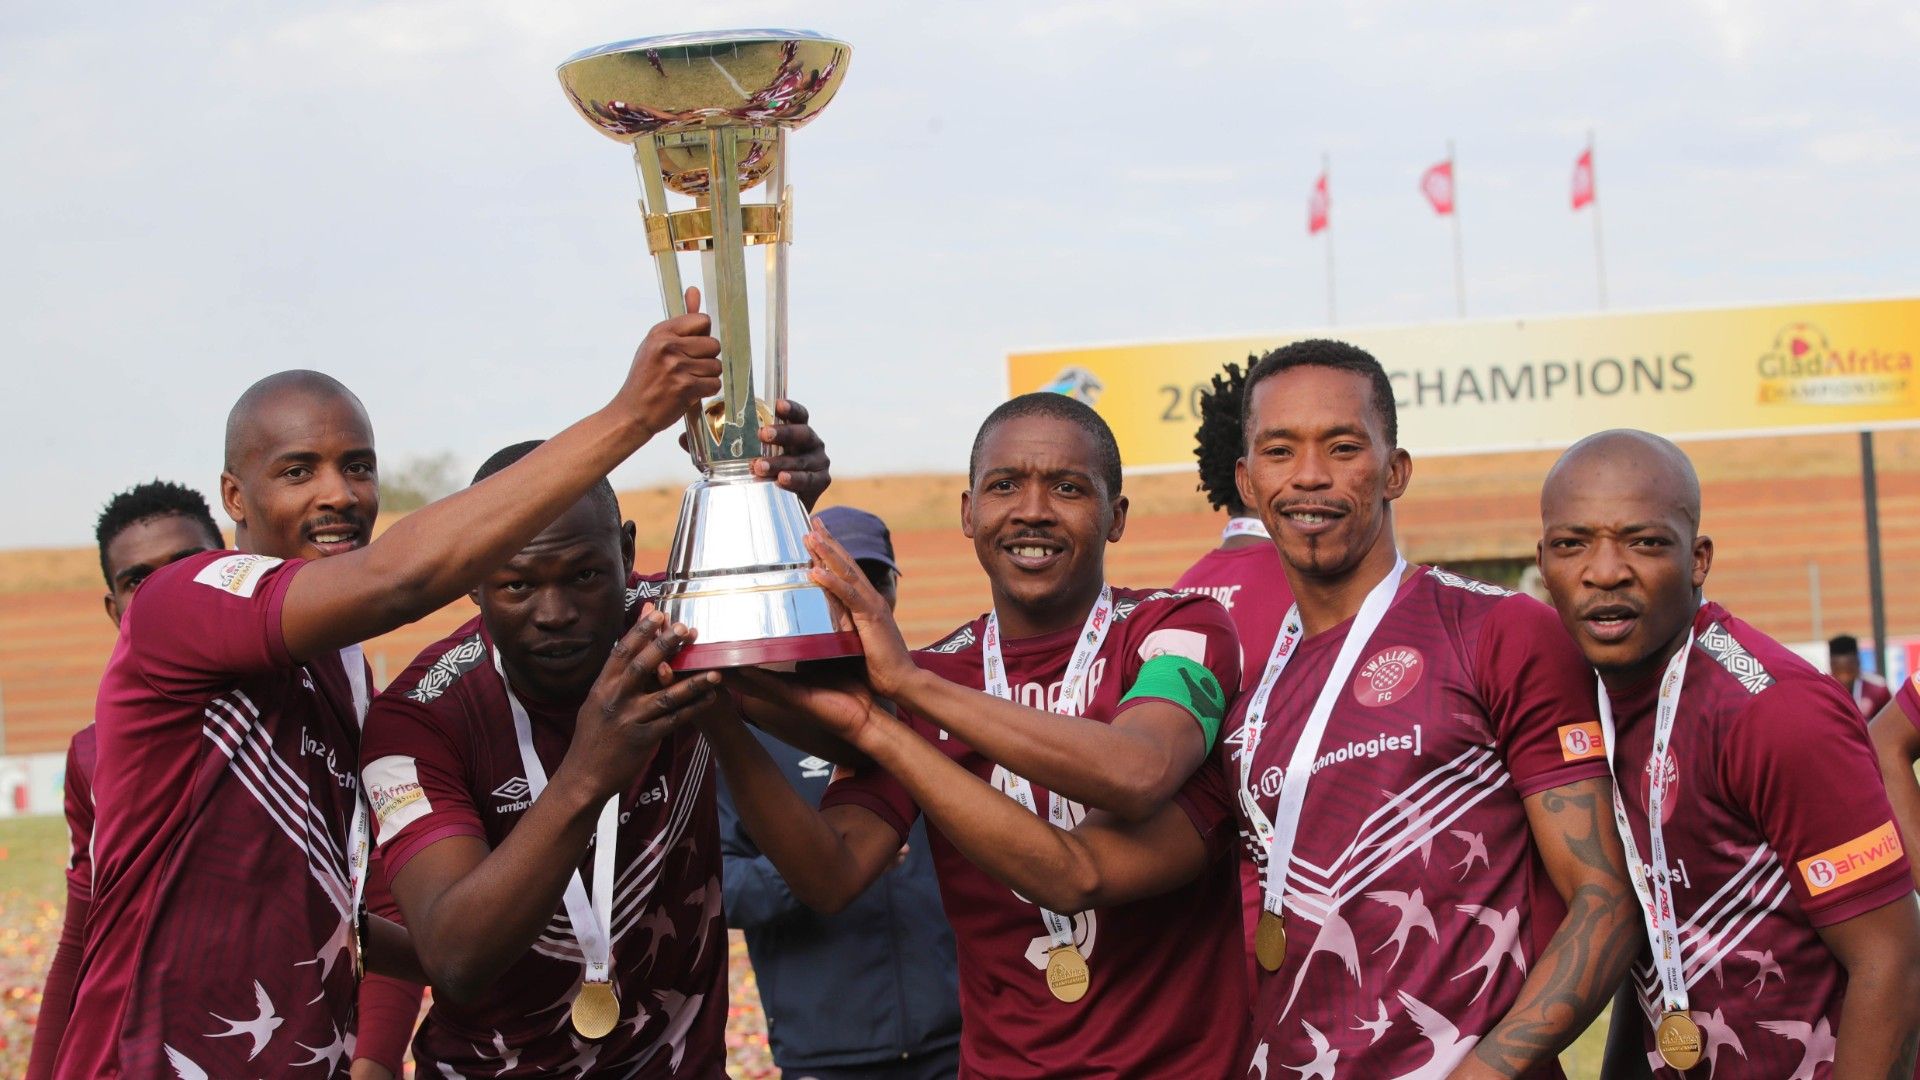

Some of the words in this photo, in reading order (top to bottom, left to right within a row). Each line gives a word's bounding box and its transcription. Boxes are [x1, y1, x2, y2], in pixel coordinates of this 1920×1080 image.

[1757, 348, 1913, 379] GladAfrica
[1389, 353, 1696, 407] CHAMPIONS
[1276, 636, 1294, 658] PSL
[1361, 650, 1418, 678] SWALLOWS
[1377, 691, 1392, 703] FC
[1659, 887, 1670, 920] PSL
